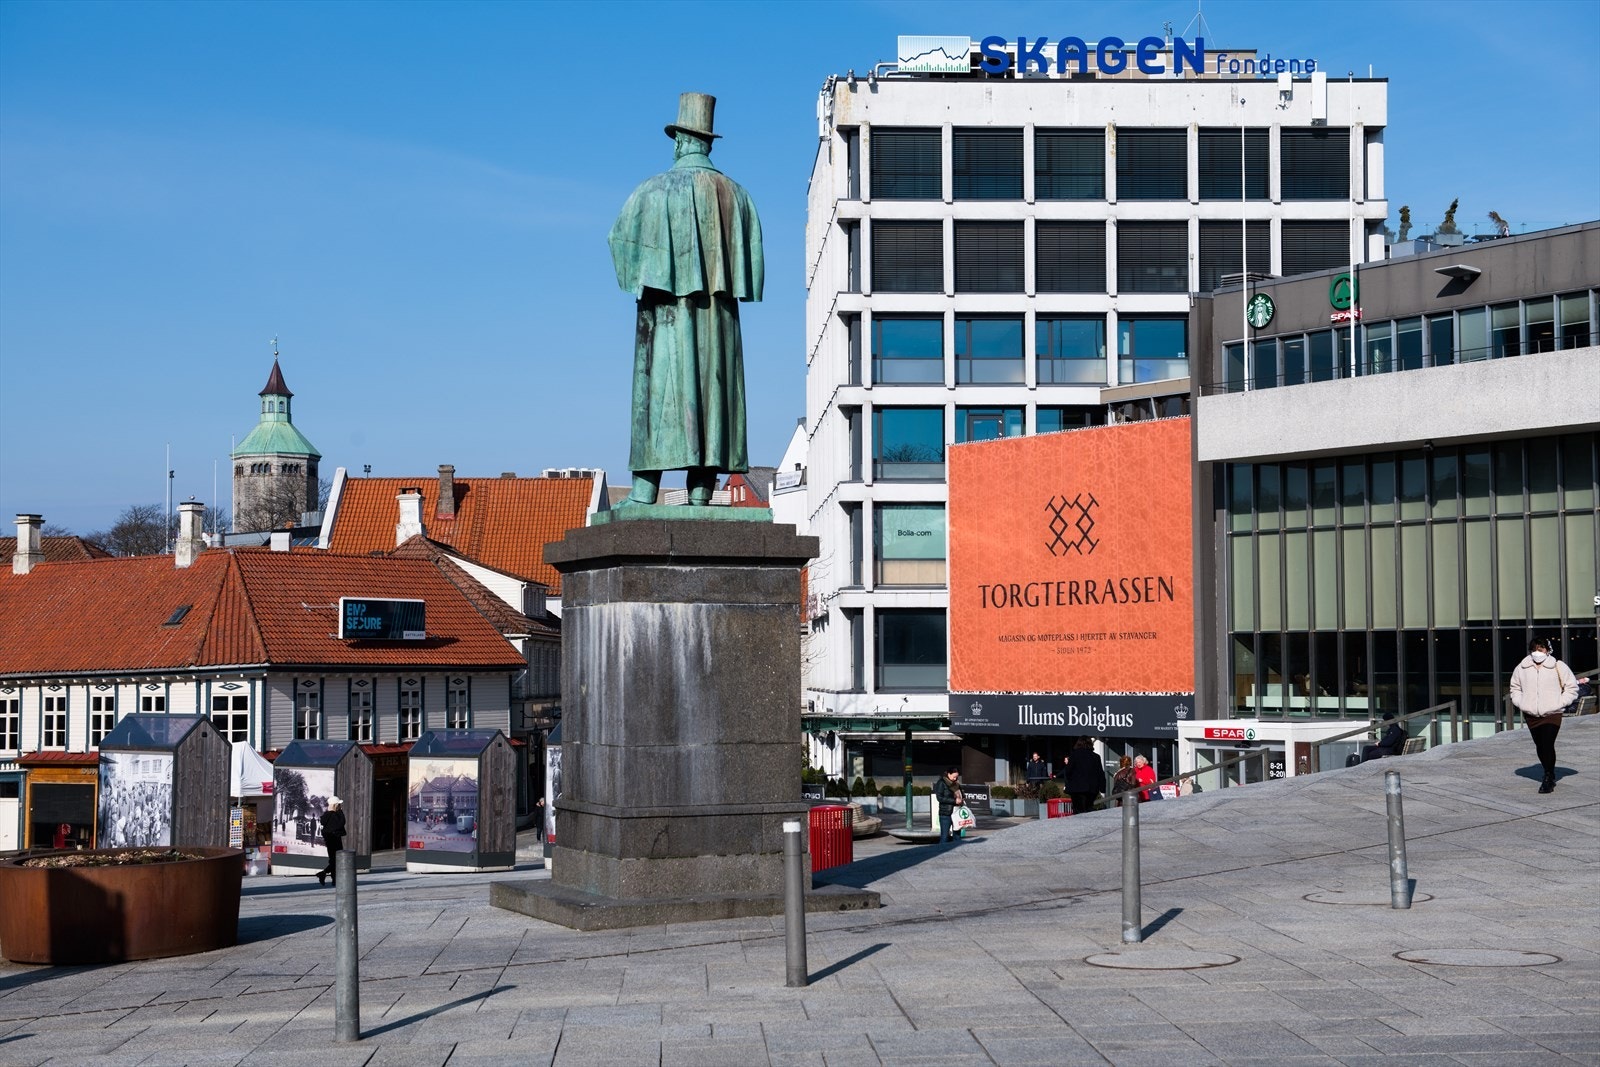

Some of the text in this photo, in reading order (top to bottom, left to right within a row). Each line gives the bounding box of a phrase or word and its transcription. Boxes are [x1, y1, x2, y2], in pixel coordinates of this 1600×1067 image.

[979, 35, 1317, 75] SKAGEN fondene
[978, 575, 1175, 609] TORGTERRASSEN
[346, 617, 382, 630] SECURE
[998, 634, 1026, 642] MAGASIN
[1027, 634, 1036, 642] OG
[1037, 633, 1075, 642] MØTEPLASS
[1080, 632, 1107, 641] HJERTET
[1109, 632, 1117, 640] AV
[1119, 631, 1157, 640] STAVANGER
[1056, 646, 1091, 655] SIDEN 1972
[1018, 704, 1134, 732] Illums Bolighus
[1212, 729, 1245, 738] SPAR
[1269, 762, 1283, 770] 8-21
